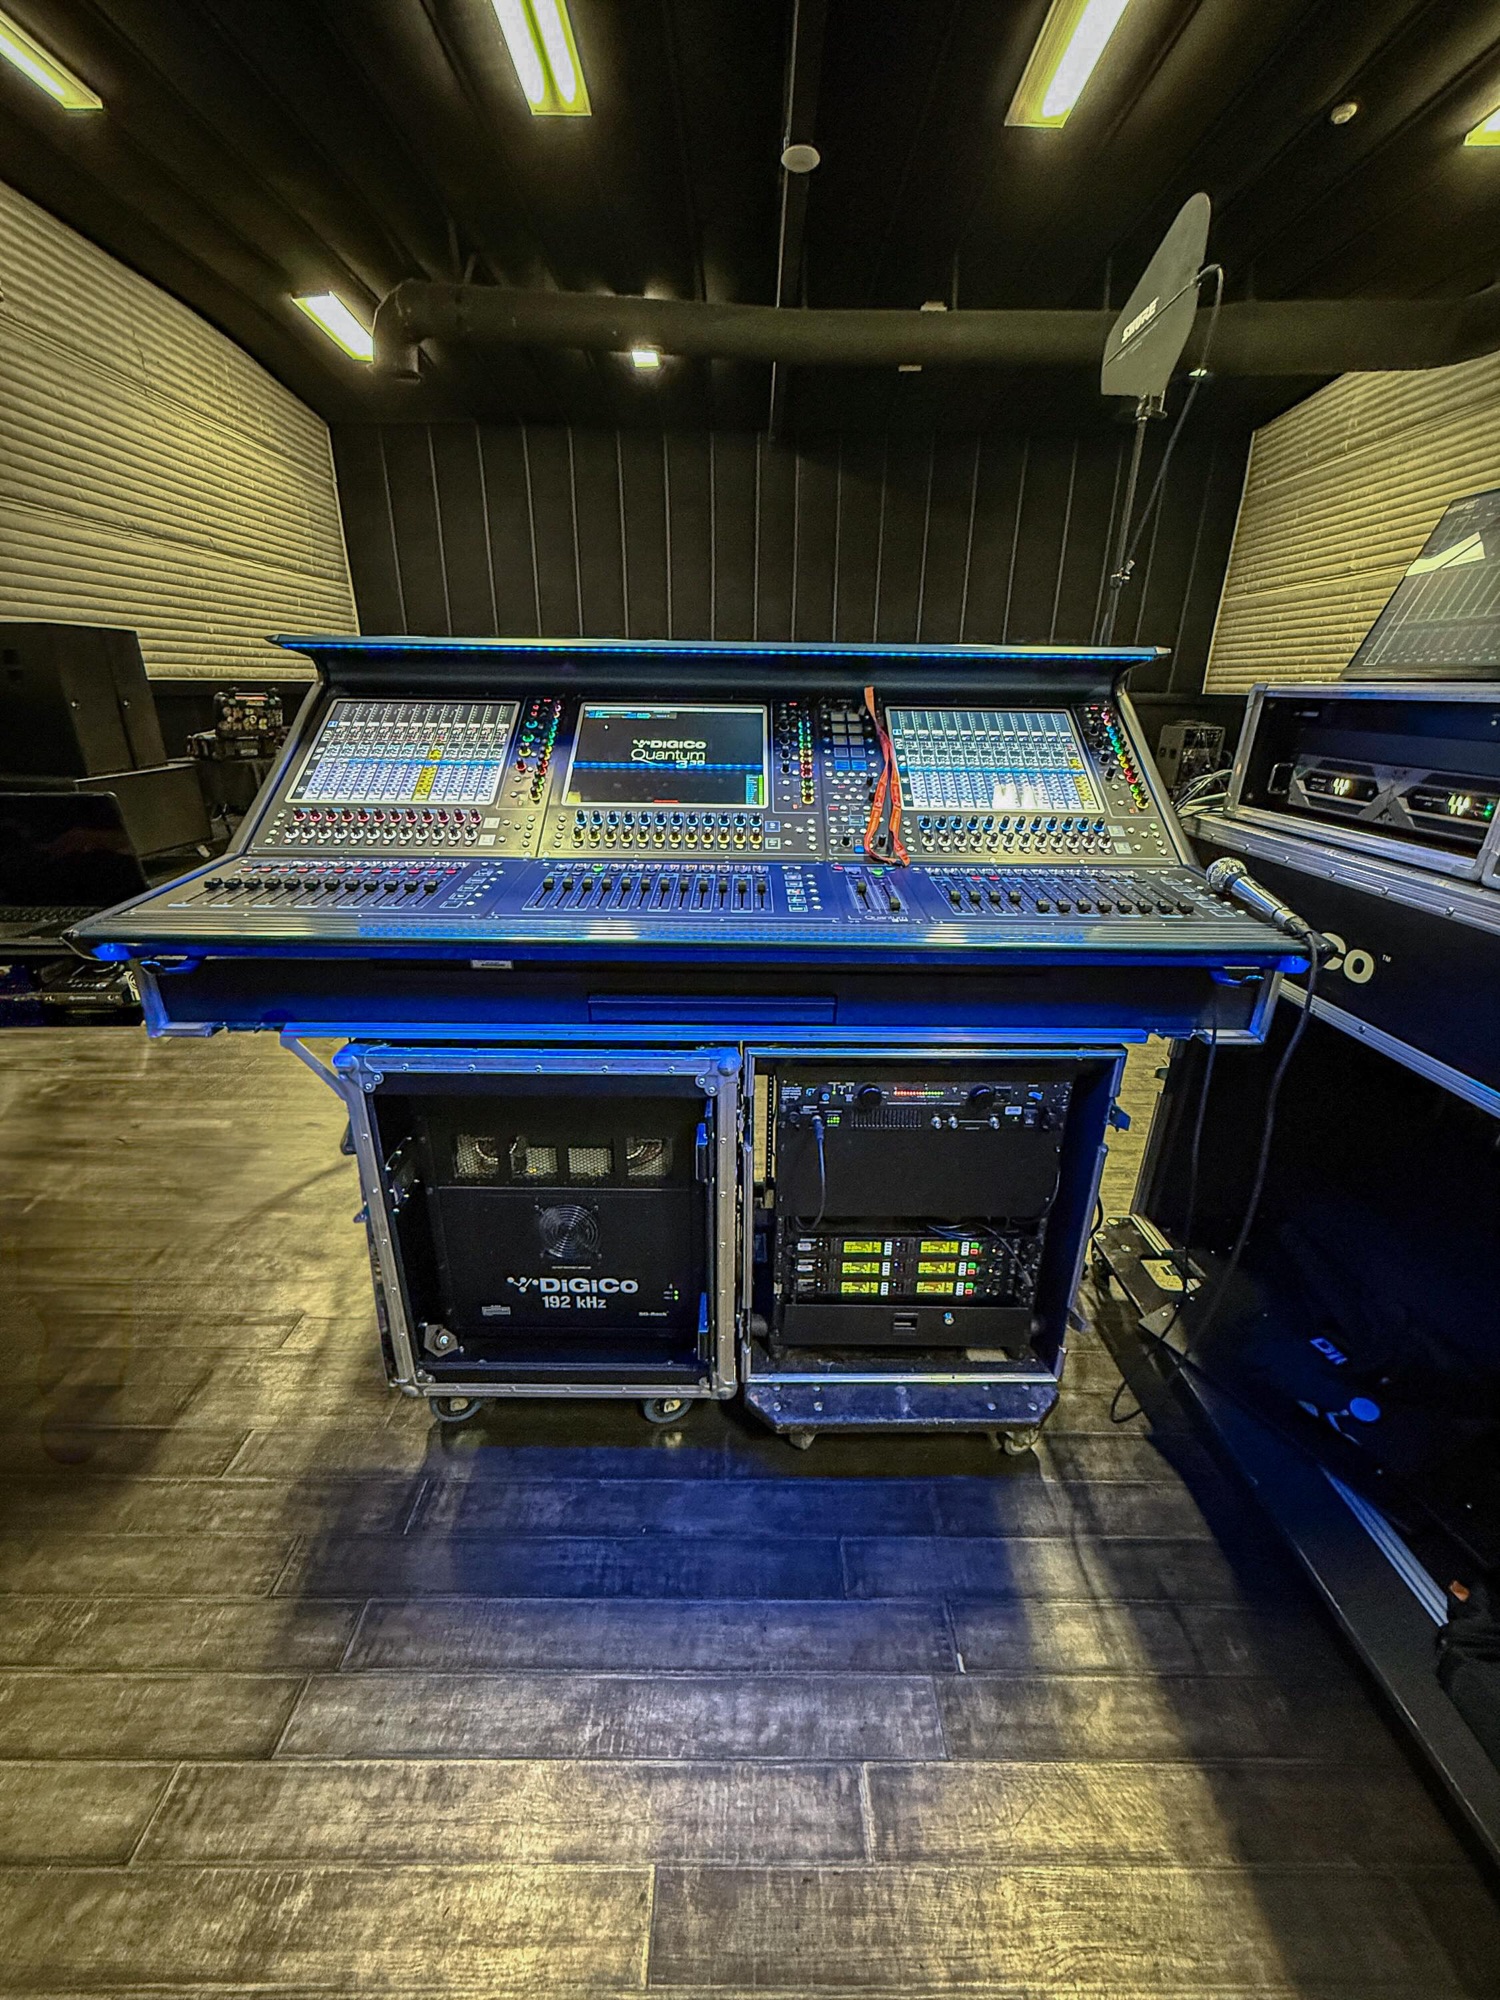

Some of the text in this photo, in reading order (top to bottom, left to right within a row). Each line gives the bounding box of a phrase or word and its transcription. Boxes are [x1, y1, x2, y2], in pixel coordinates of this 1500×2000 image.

[631, 748, 706, 765] Quantum
[539, 1277, 639, 1294] DiGiCo
[542, 1295, 607, 1309] 192 kHz
